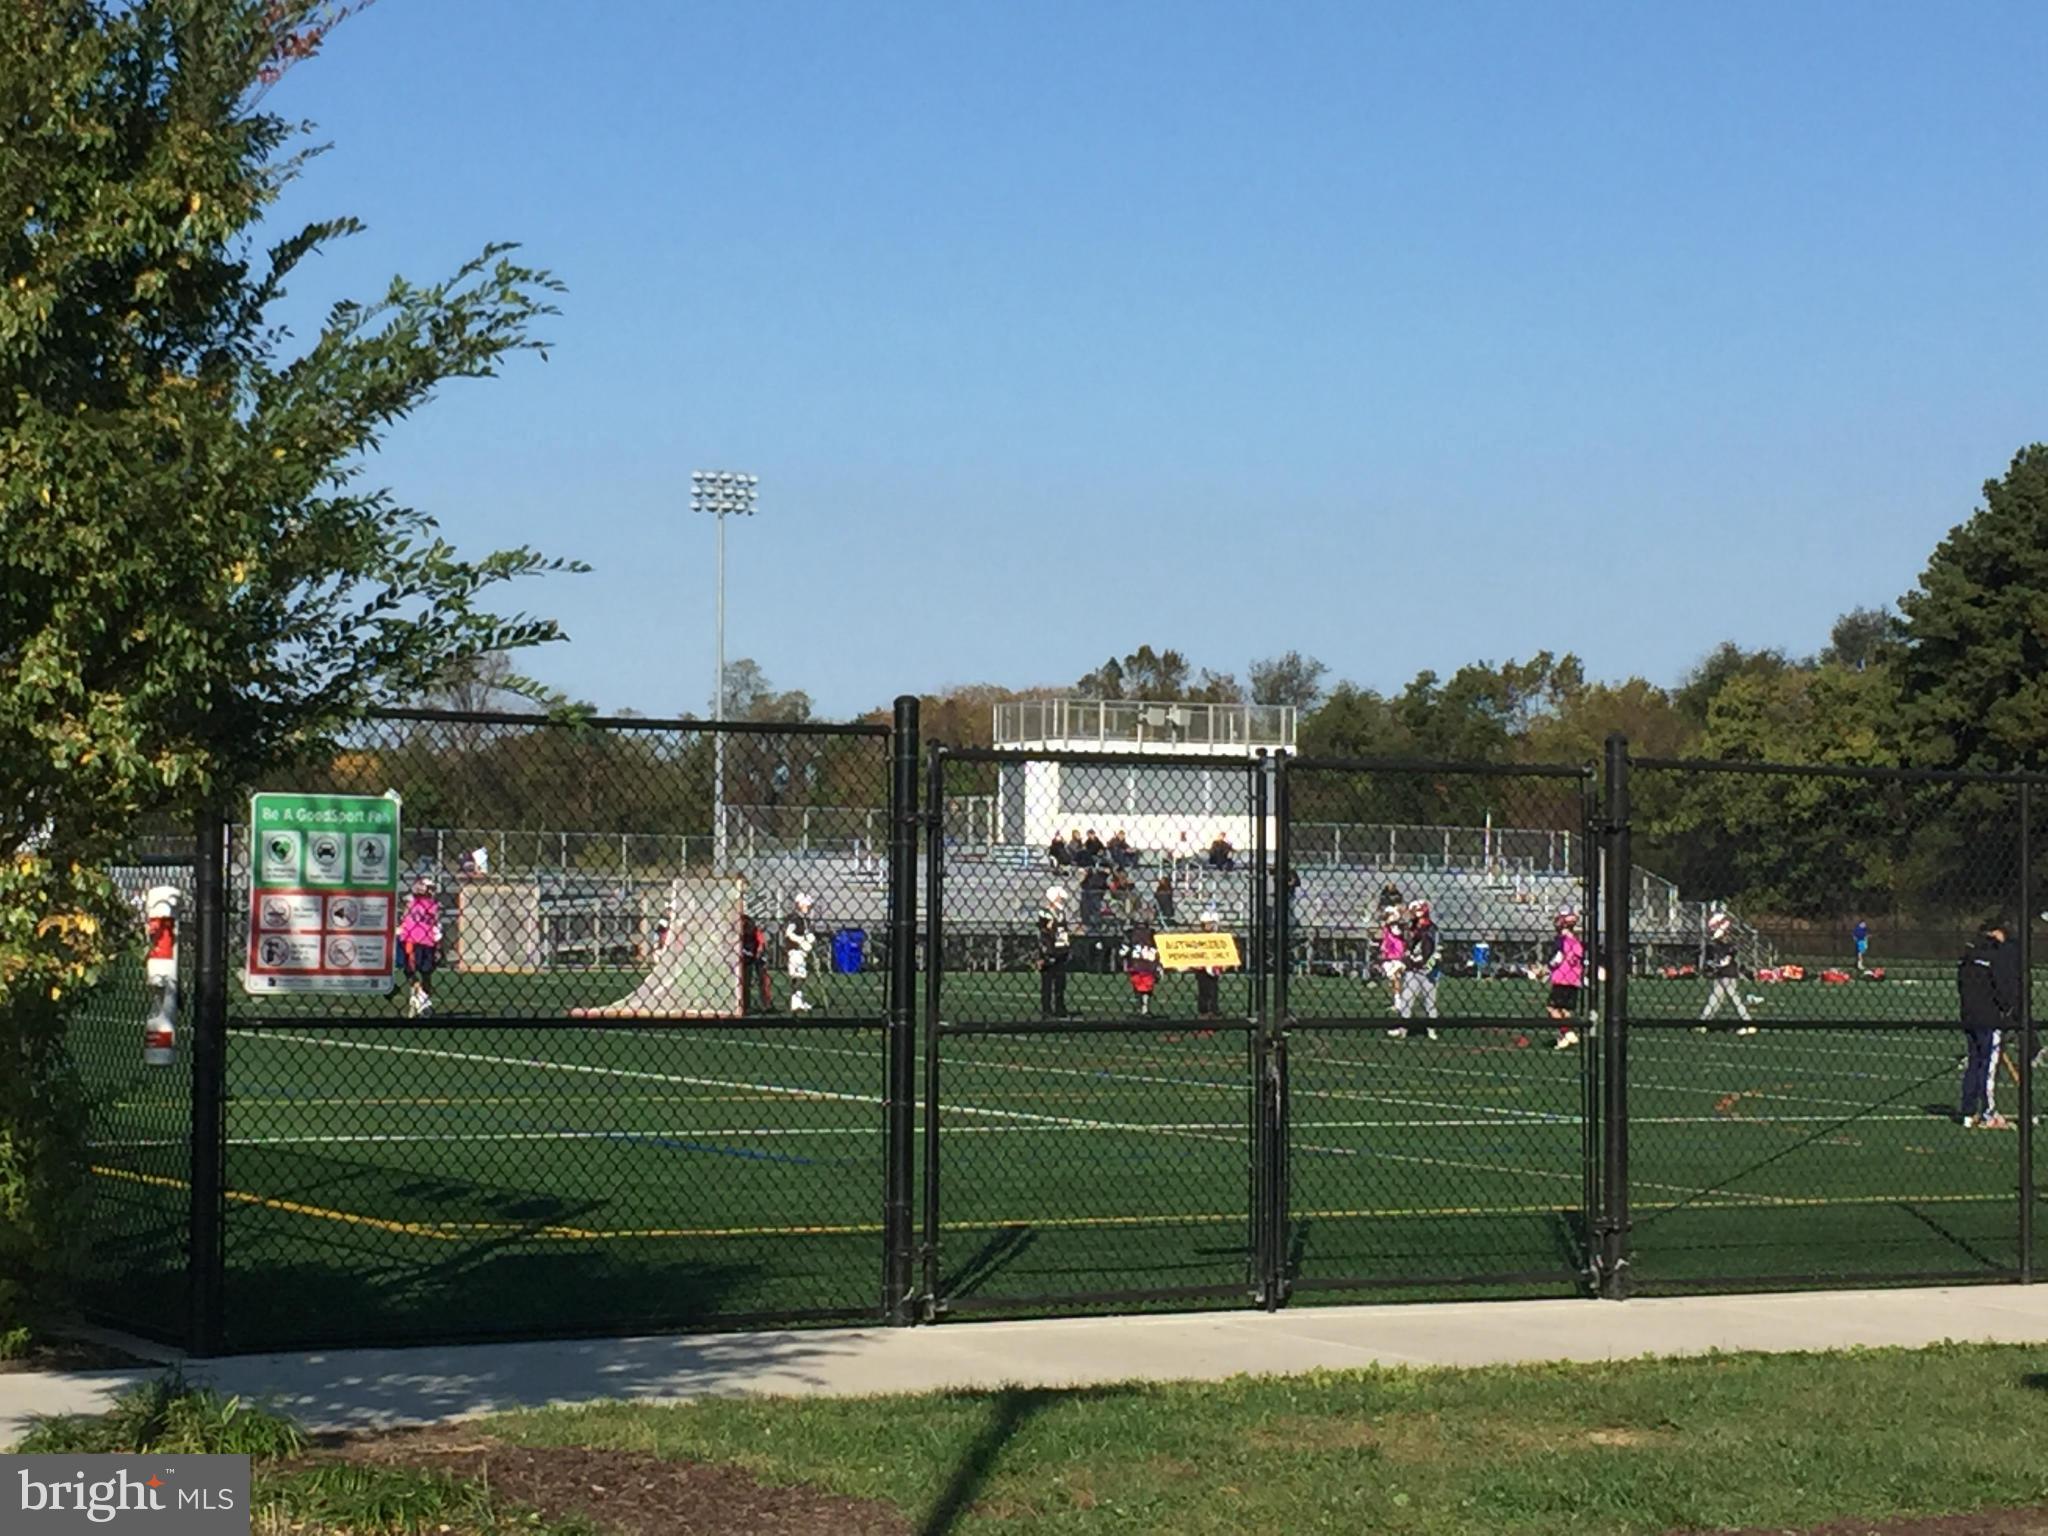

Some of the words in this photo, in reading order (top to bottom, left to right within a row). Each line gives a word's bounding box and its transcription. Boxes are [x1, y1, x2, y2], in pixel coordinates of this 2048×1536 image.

[262, 807, 279, 821] Be
[283, 808, 293, 821] A
[368, 811, 391, 824] Fan
